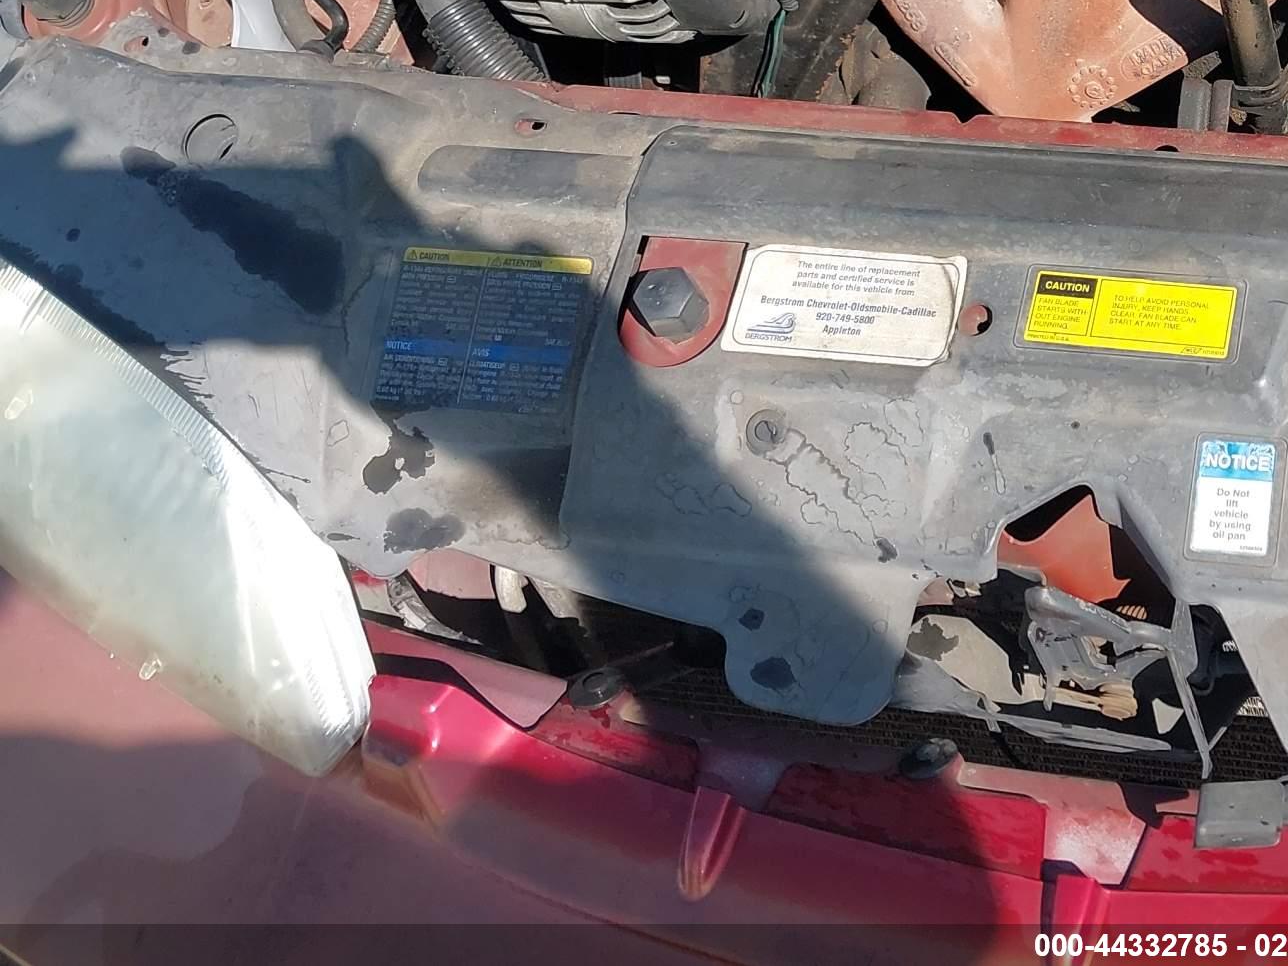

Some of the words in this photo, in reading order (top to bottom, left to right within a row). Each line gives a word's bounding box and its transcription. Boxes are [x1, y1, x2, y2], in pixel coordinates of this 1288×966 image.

[419, 252, 450, 261] CAUTION
[502, 259, 543, 268] ATTENTION
[797, 260, 813, 269] The
[814, 261, 839, 271] entire
[841, 262, 856, 272] line
[868, 266, 921, 278] replacement
[797, 271, 819, 279] parts
[820, 272, 837, 280] and
[839, 274, 873, 283] certified
[874, 277, 906, 286] service
[792, 280, 830, 290] available
[831, 282, 844, 291] for
[845, 284, 861, 292] this
[863, 286, 893, 294] vehicle
[894, 287, 915, 296] from
[1045, 280, 1090, 293] CAUTION
[760, 295, 805, 307] Bergstrom
[806, 298, 937, 318] Chevrolet-Oldsmobile-Cadillac
[1055, 298, 1080, 307] BLADE
[1114, 294, 1124, 302] TO
[1125, 295, 1145, 303] HELP
[1146, 298, 1169, 306] AVOID
[1170, 299, 1209, 310] PERSONAL
[1037, 305, 1066, 314] STARTS
[1163, 306, 1189, 315] HANDS
[815, 312, 876, 324] 920-749-5800
[1034, 312, 1052, 320] OUT
[1052, 314, 1081, 323] ENGINE
[1155, 313, 1178, 322] BLADE
[1180, 315, 1197, 323] CAN
[822, 324, 862, 336] Appleton
[1145, 321, 1162, 329] ANY
[744, 332, 793, 342] BERGSTROM
[386, 340, 413, 350] NOTICE
[472, 348, 490, 357] AVIS
[1205, 453, 1271, 472] NOTICE
[1216, 488, 1230, 497] Do
[1233, 489, 1250, 498] Not
[1226, 499, 1239, 508] lift
[1214, 509, 1249, 520] vehicle
[1209, 519, 1221, 529] by
[1224, 521, 1252, 532] using
[1212, 530, 1225, 539] oil
[1227, 532, 1246, 541] pan
